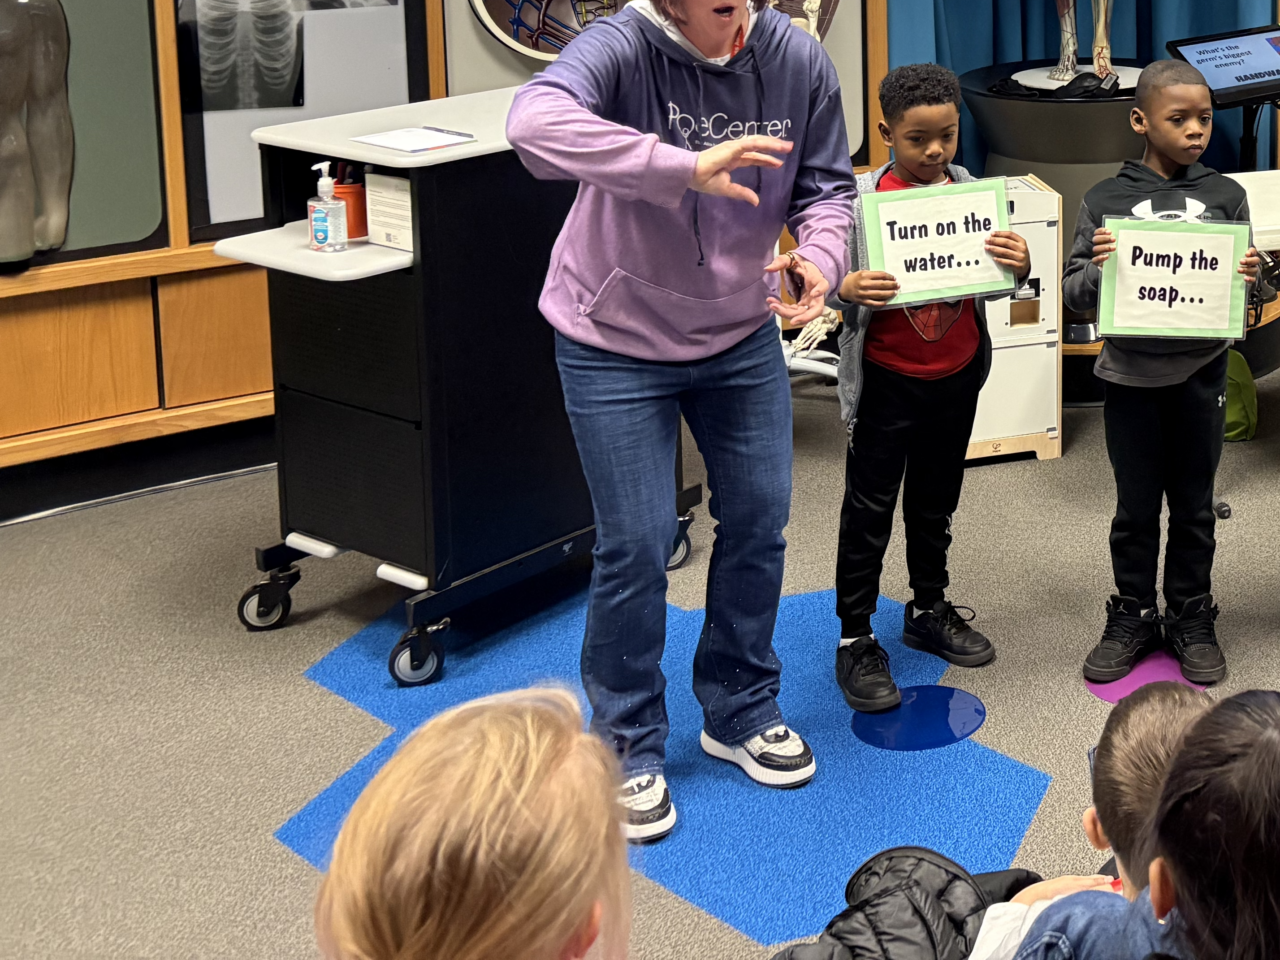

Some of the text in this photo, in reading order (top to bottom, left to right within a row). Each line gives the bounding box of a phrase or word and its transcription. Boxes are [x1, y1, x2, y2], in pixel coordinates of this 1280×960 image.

[1214, 58, 1246, 69] enemy?
[1223, 49, 1253, 60] biggest
[886, 212, 992, 241] Turn on the
[903, 252, 980, 273] water...
[1130, 245, 1219, 275] Pump the
[1137, 285, 1204, 309] soap...
